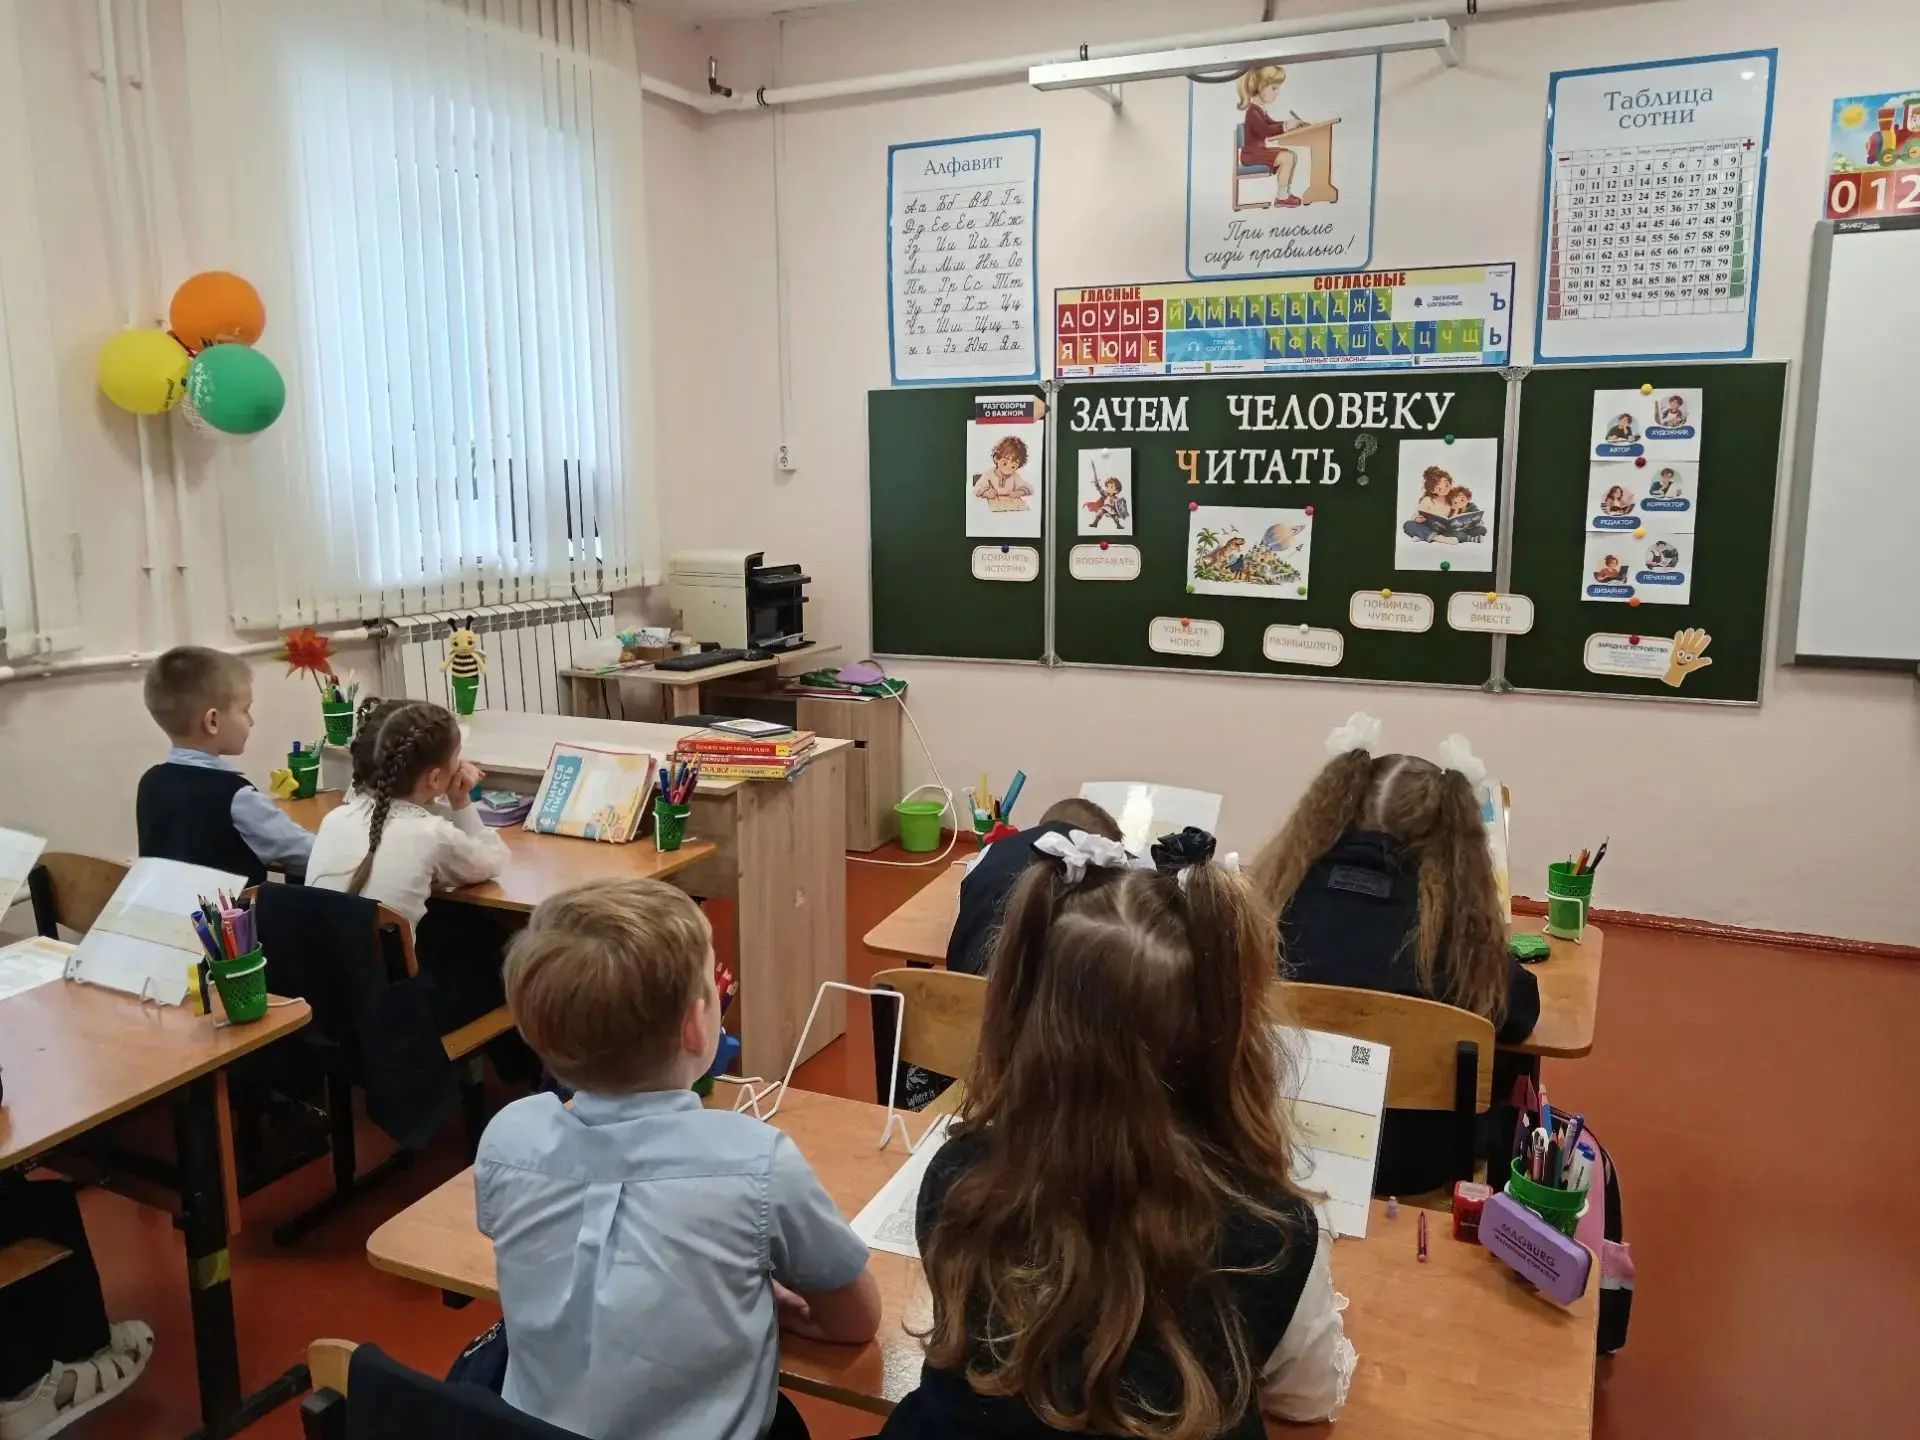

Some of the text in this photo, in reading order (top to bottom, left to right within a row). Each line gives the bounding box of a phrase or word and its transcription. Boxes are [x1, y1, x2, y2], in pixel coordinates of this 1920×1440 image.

[1604, 88, 1713, 111] Таблица
[1619, 108, 1696, 129] сотни
[924, 157, 1003, 177] Алфавит
[1580, 157, 1737, 177] 0 1 2 3 4 5 6 7 8 9
[1574, 172, 1735, 191] 10 11 12 13 14 15 16 17 18 19
[1831, 174, 1920, 214] 0 1 2
[1223, 220, 1334, 248] При письме
[1204, 234, 1355, 269] сиди правильно!
[1313, 272, 1406, 291] СОГЛАСНЫЕ
[1080, 287, 1141, 302] ГЛАСНЫЕ
[1489, 292, 1506, 311] Ъ
[1567, 294, 1578, 303] 90
[1583, 293, 1593, 302] 91
[1599, 293, 1609, 301] 92
[1615, 292, 1625, 300] 93
[1632, 291, 1642, 299] 94
[1648, 290, 1659, 298] 95
[1664, 289, 1675, 298] 96
[1698, 288, 1709, 296] 98
[1715, 287, 1726, 295] 99
[1061, 307, 1160, 328] А О У Ы Э
[1169, 303, 1182, 321] Й
[1188, 306, 1201, 320] Л
[1207, 305, 1222, 319] М
[1230, 304, 1241, 318] Н
[1251, 303, 1260, 318] Р
[1271, 302, 1281, 317] Б
[1291, 301, 1301, 316] В
[1312, 300, 1320, 316] Г
[1332, 300, 1344, 316] Д
[1353, 297, 1366, 313] Ж
[1564, 307, 1578, 317] 100
[1269, 329, 1479, 350] П Ф К Т Ш С Х Ц Ч Щ
[1489, 327, 1502, 346] Ь
[1061, 338, 1158, 360] Я Ё Ю И Е
[982, 402, 1026, 410] РАЗГОВОРЫ
[1070, 391, 1455, 432] ЗАЧЕМ ЧЕЛОВЕКУ
[981, 554, 1030, 563] СОХРАНЯТЬ
[1075, 556, 1135, 566] ВООБРАЖАТЬ
[984, 565, 1026, 574] ИСТОРИЮ
[1363, 599, 1421, 611] ПОНИМАТЬ
[1472, 600, 1512, 612] ЧИТАТЬ
[1368, 613, 1414, 623] ЧУВСТВА
[1470, 614, 1512, 624] ВМЕСТЕ
[1163, 625, 1210, 637] УЗНАВАТЬ
[1170, 637, 1201, 648] НОВОЕ
[1269, 636, 1338, 652] РАЗМЫШЛЯТЬ
[542, 764, 565, 812] УЧИМСЯ
[550, 766, 574, 813] ПИСАТЬ
[1502, 1224, 1554, 1266] MAGBURG
